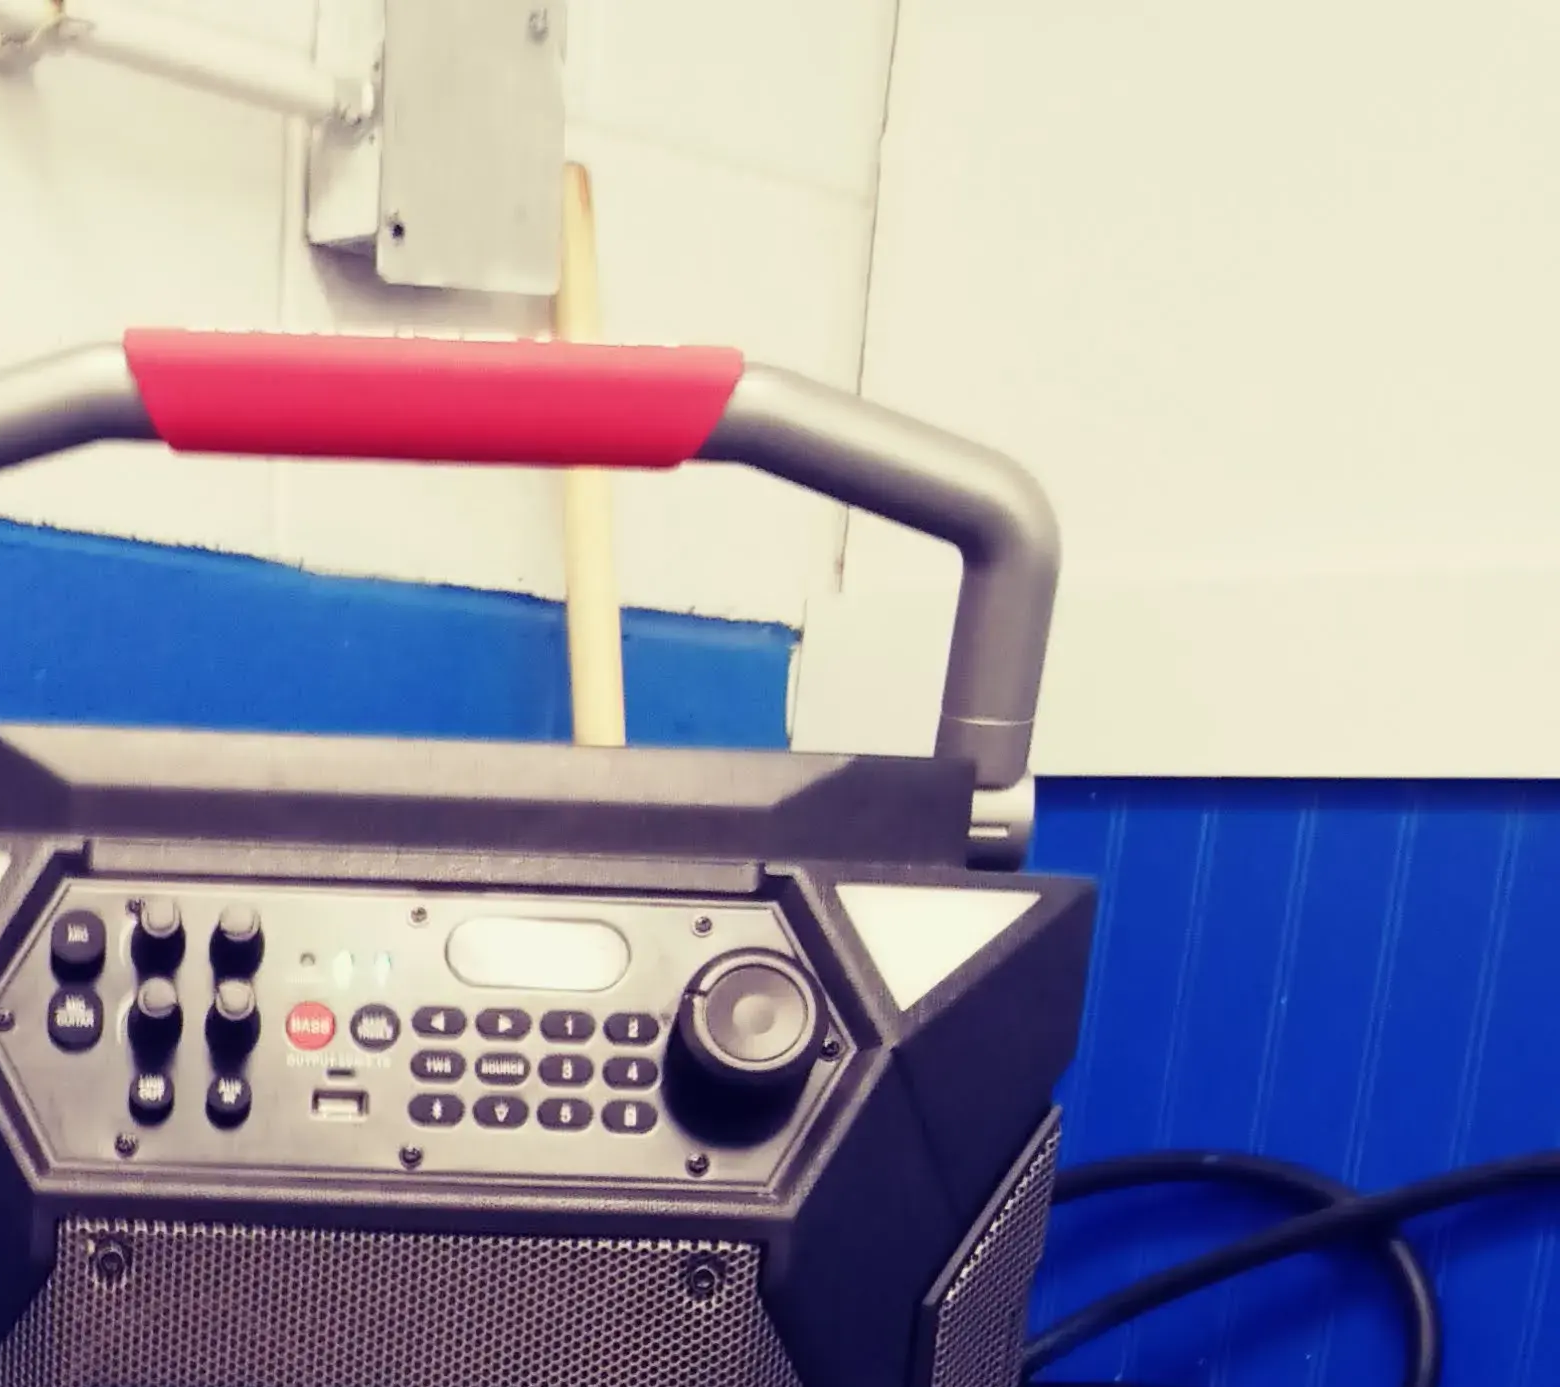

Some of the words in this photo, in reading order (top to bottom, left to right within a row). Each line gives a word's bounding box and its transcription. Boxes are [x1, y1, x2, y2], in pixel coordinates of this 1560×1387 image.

[565, 1015, 573, 1036] 1
[627, 1016, 639, 1038] 2
[627, 1060, 639, 1082] 4
